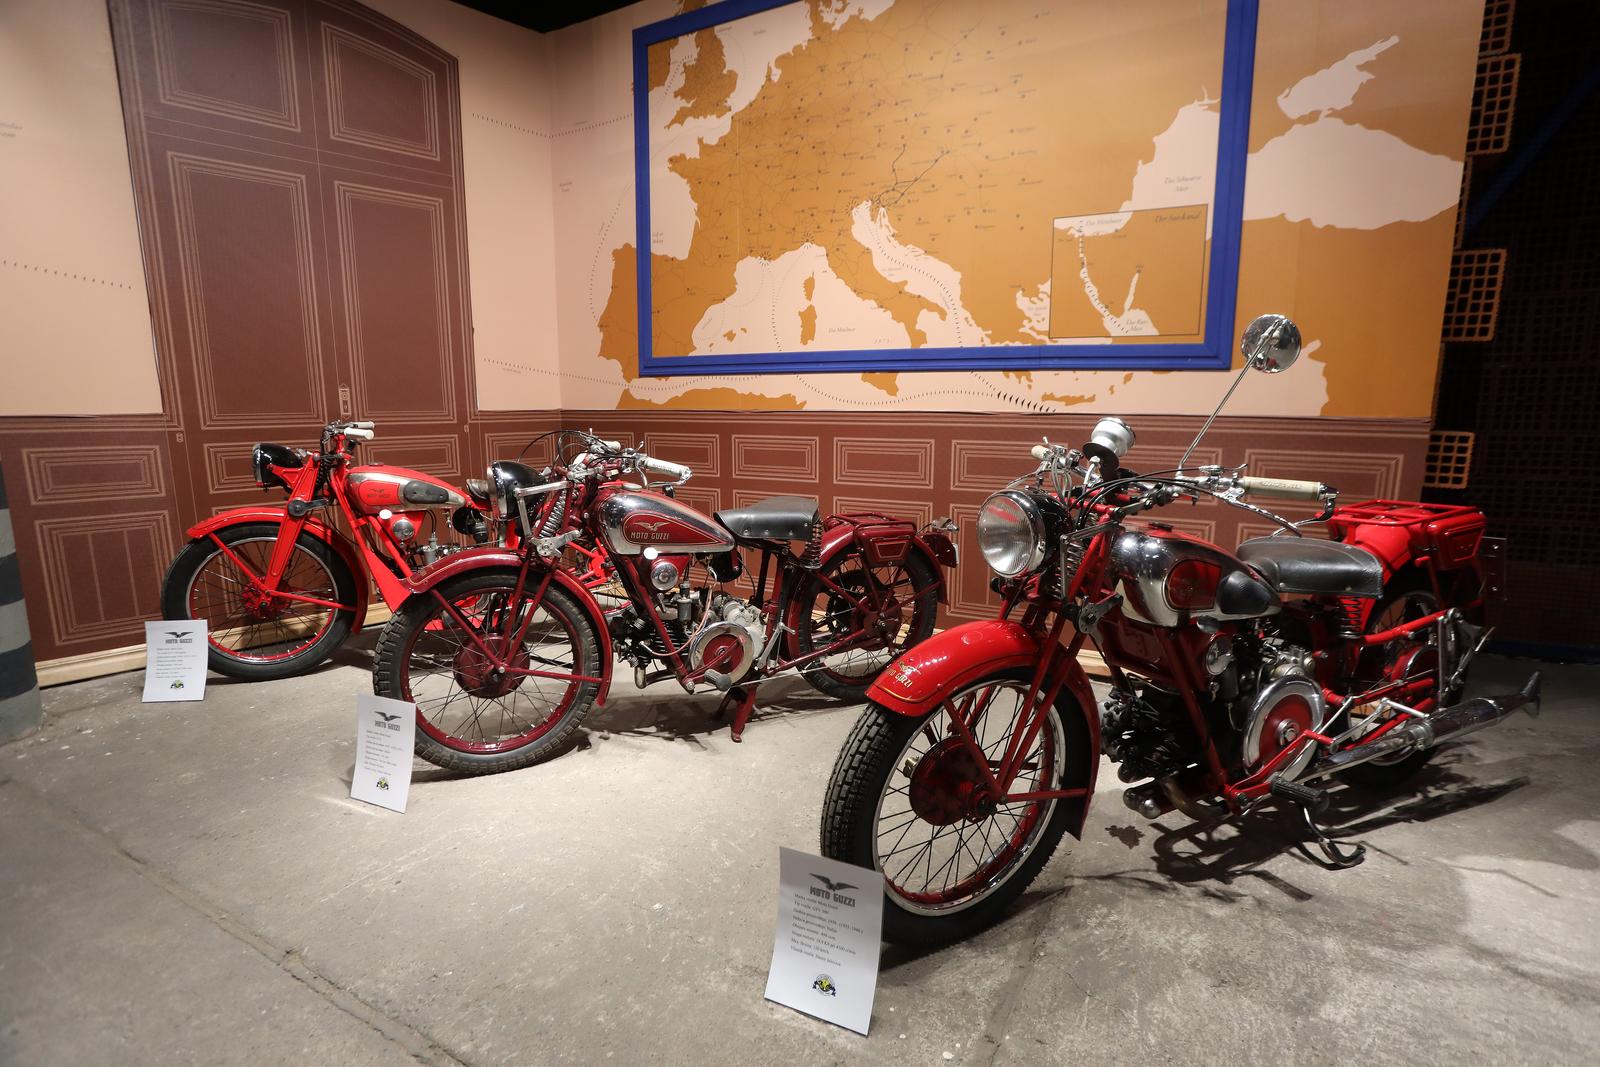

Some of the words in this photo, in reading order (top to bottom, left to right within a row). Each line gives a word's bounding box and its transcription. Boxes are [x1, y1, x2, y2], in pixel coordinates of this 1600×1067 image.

[630, 532, 648, 540] MOTO
[651, 532, 670, 540] GUZZI
[809, 886, 831, 900] MOTO
[833, 893, 856, 908] GUZZI
